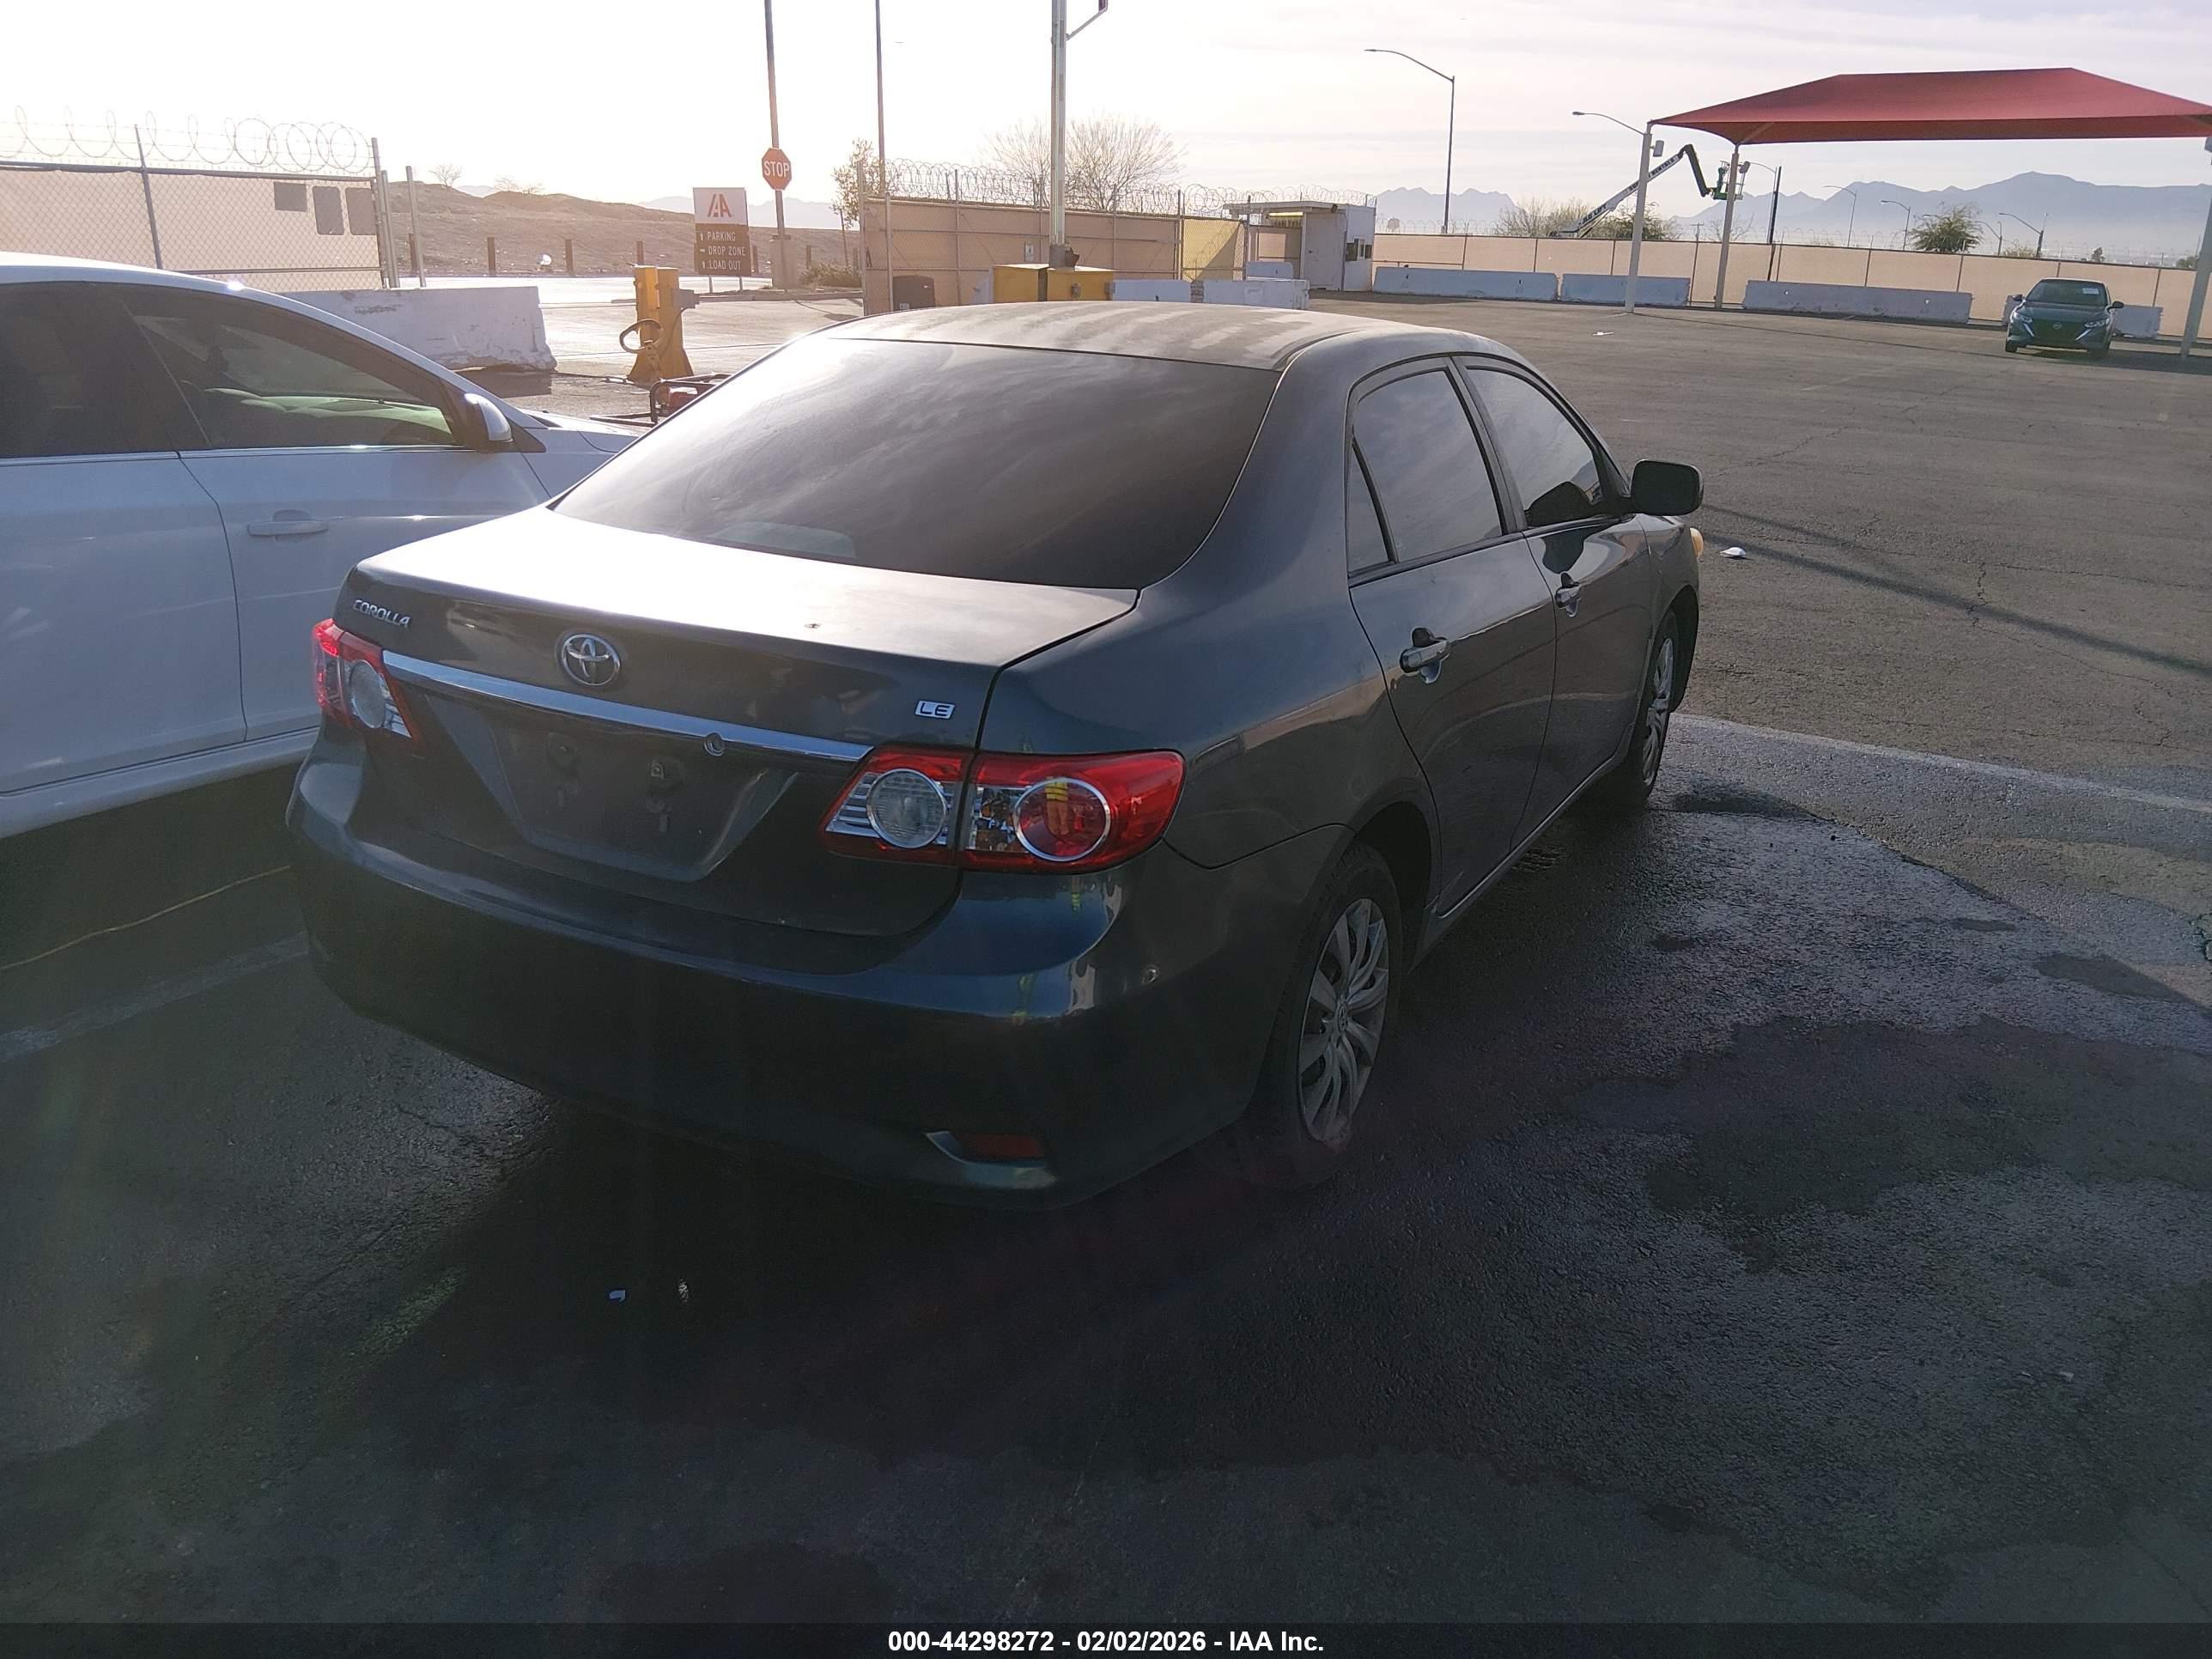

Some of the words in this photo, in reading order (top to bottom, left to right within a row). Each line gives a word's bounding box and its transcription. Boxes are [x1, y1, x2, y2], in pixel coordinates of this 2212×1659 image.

[764, 161, 790, 178] STOP
[707, 231, 736, 241] PARKING
[708, 246, 726, 255] DROP
[728, 246, 745, 256] ZONE
[708, 259, 726, 270] LOAD
[728, 260, 741, 270] OUT
[353, 599, 410, 628] COROLLA
[919, 702, 951, 717] LE
